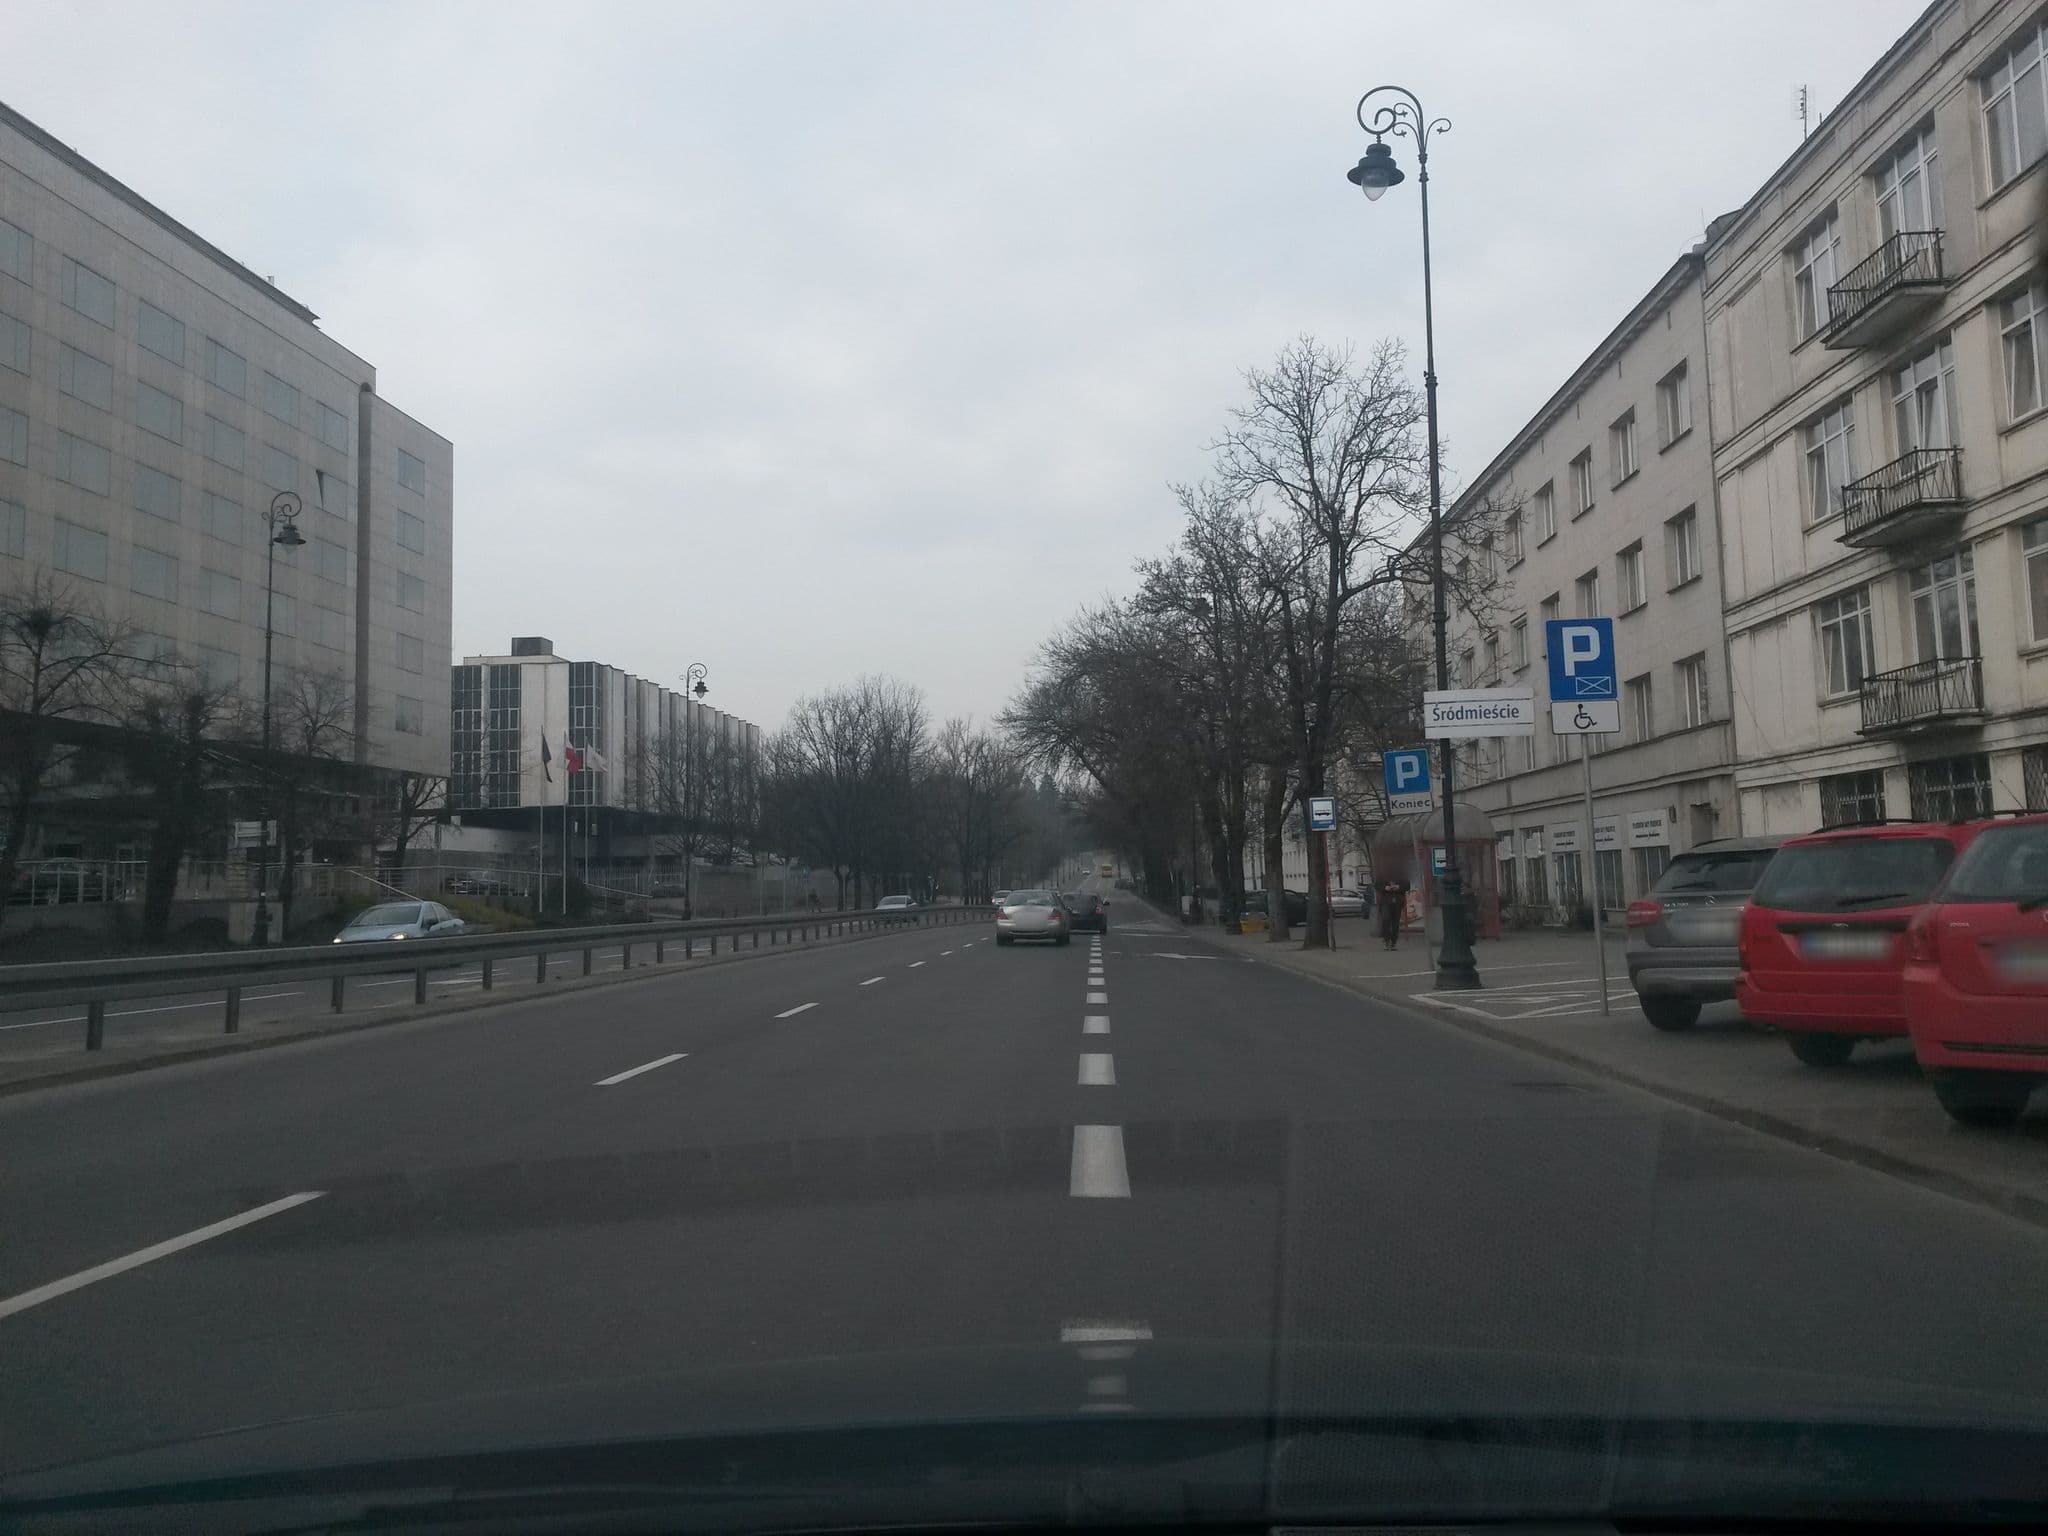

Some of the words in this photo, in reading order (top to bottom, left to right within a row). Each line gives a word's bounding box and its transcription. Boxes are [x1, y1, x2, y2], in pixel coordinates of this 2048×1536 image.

[1562, 626, 1600, 676] P
[1433, 704, 1519, 721] Śródmieście
[1395, 756, 1419, 788] P
[1391, 800, 1431, 809] Koniec
